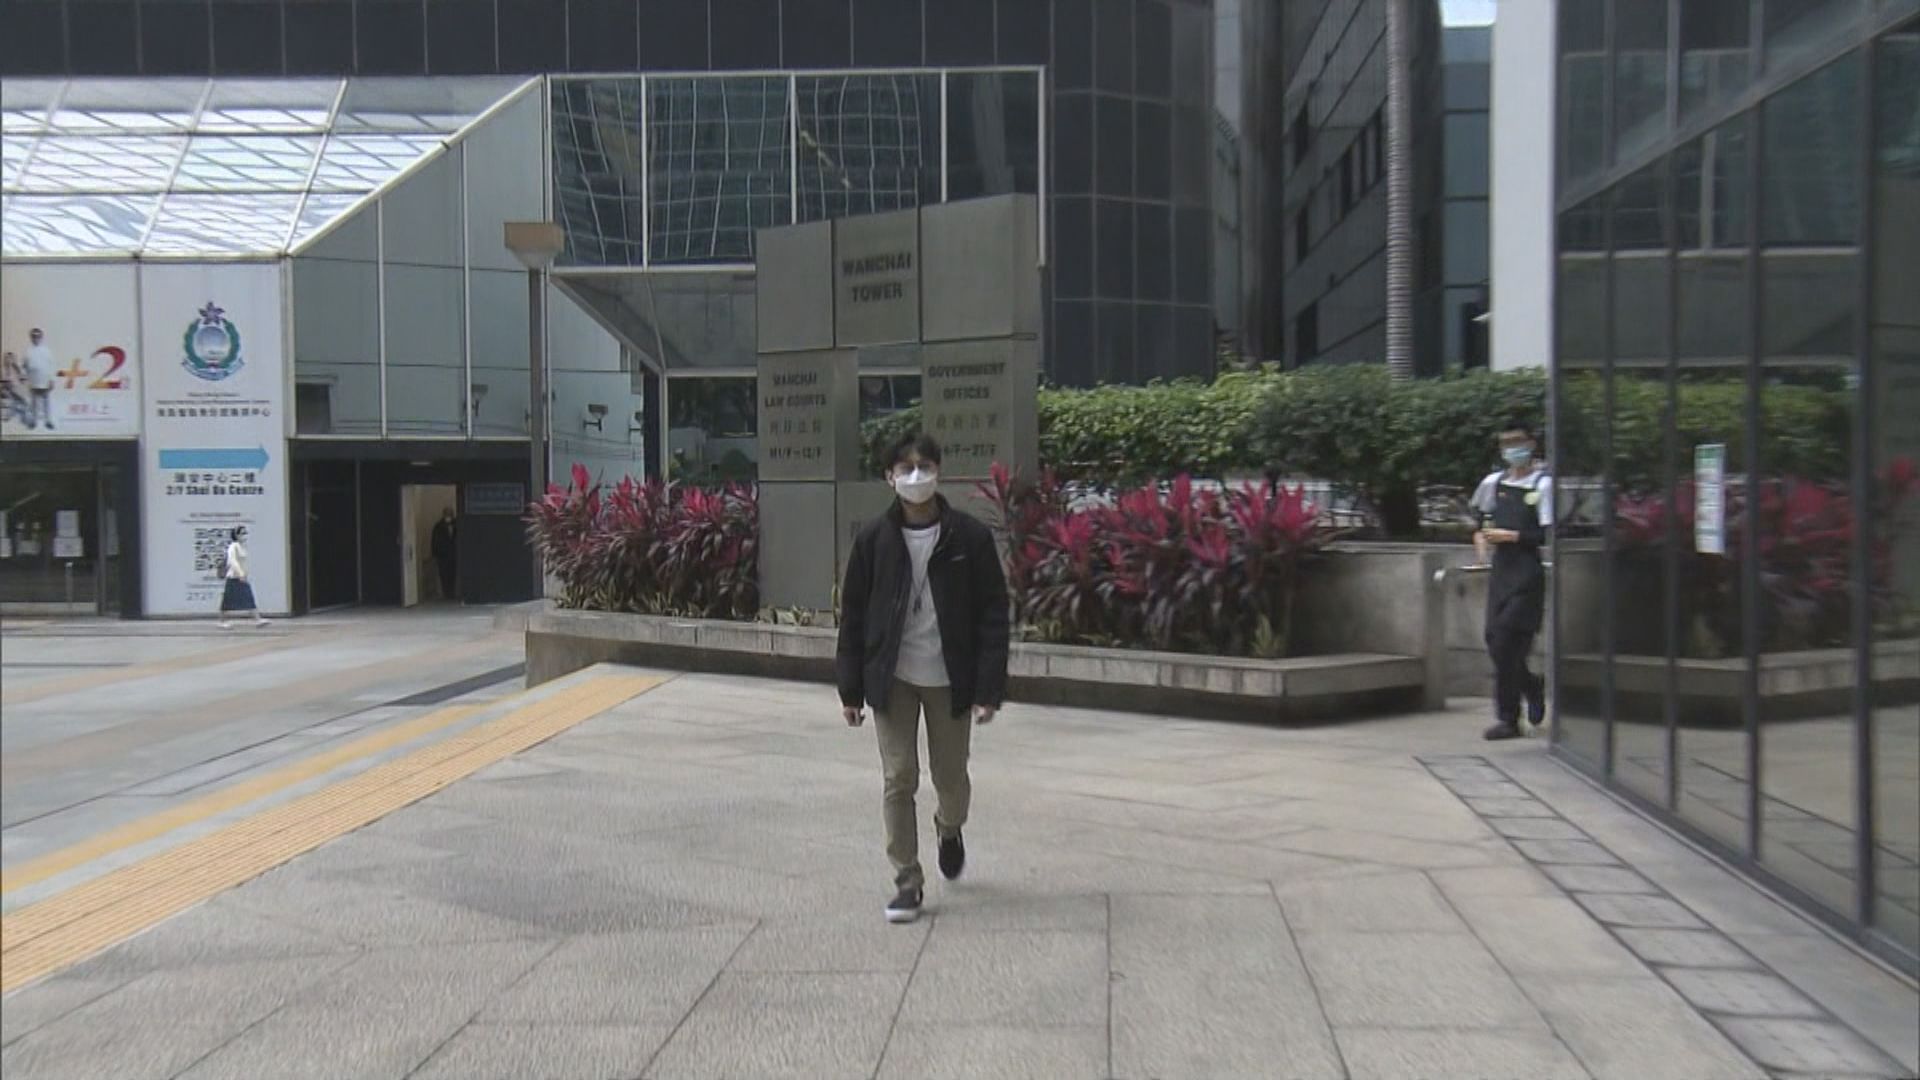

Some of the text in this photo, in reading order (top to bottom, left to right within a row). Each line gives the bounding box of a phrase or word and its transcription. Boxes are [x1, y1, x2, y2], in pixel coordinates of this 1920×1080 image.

[842, 252, 911, 277] WANCHAI
[852, 283, 903, 303] TOWER
[928, 362, 1006, 378] GOVERNMENT
[764, 395, 784, 408] LAW
[943, 387, 990, 401] OFFICES
